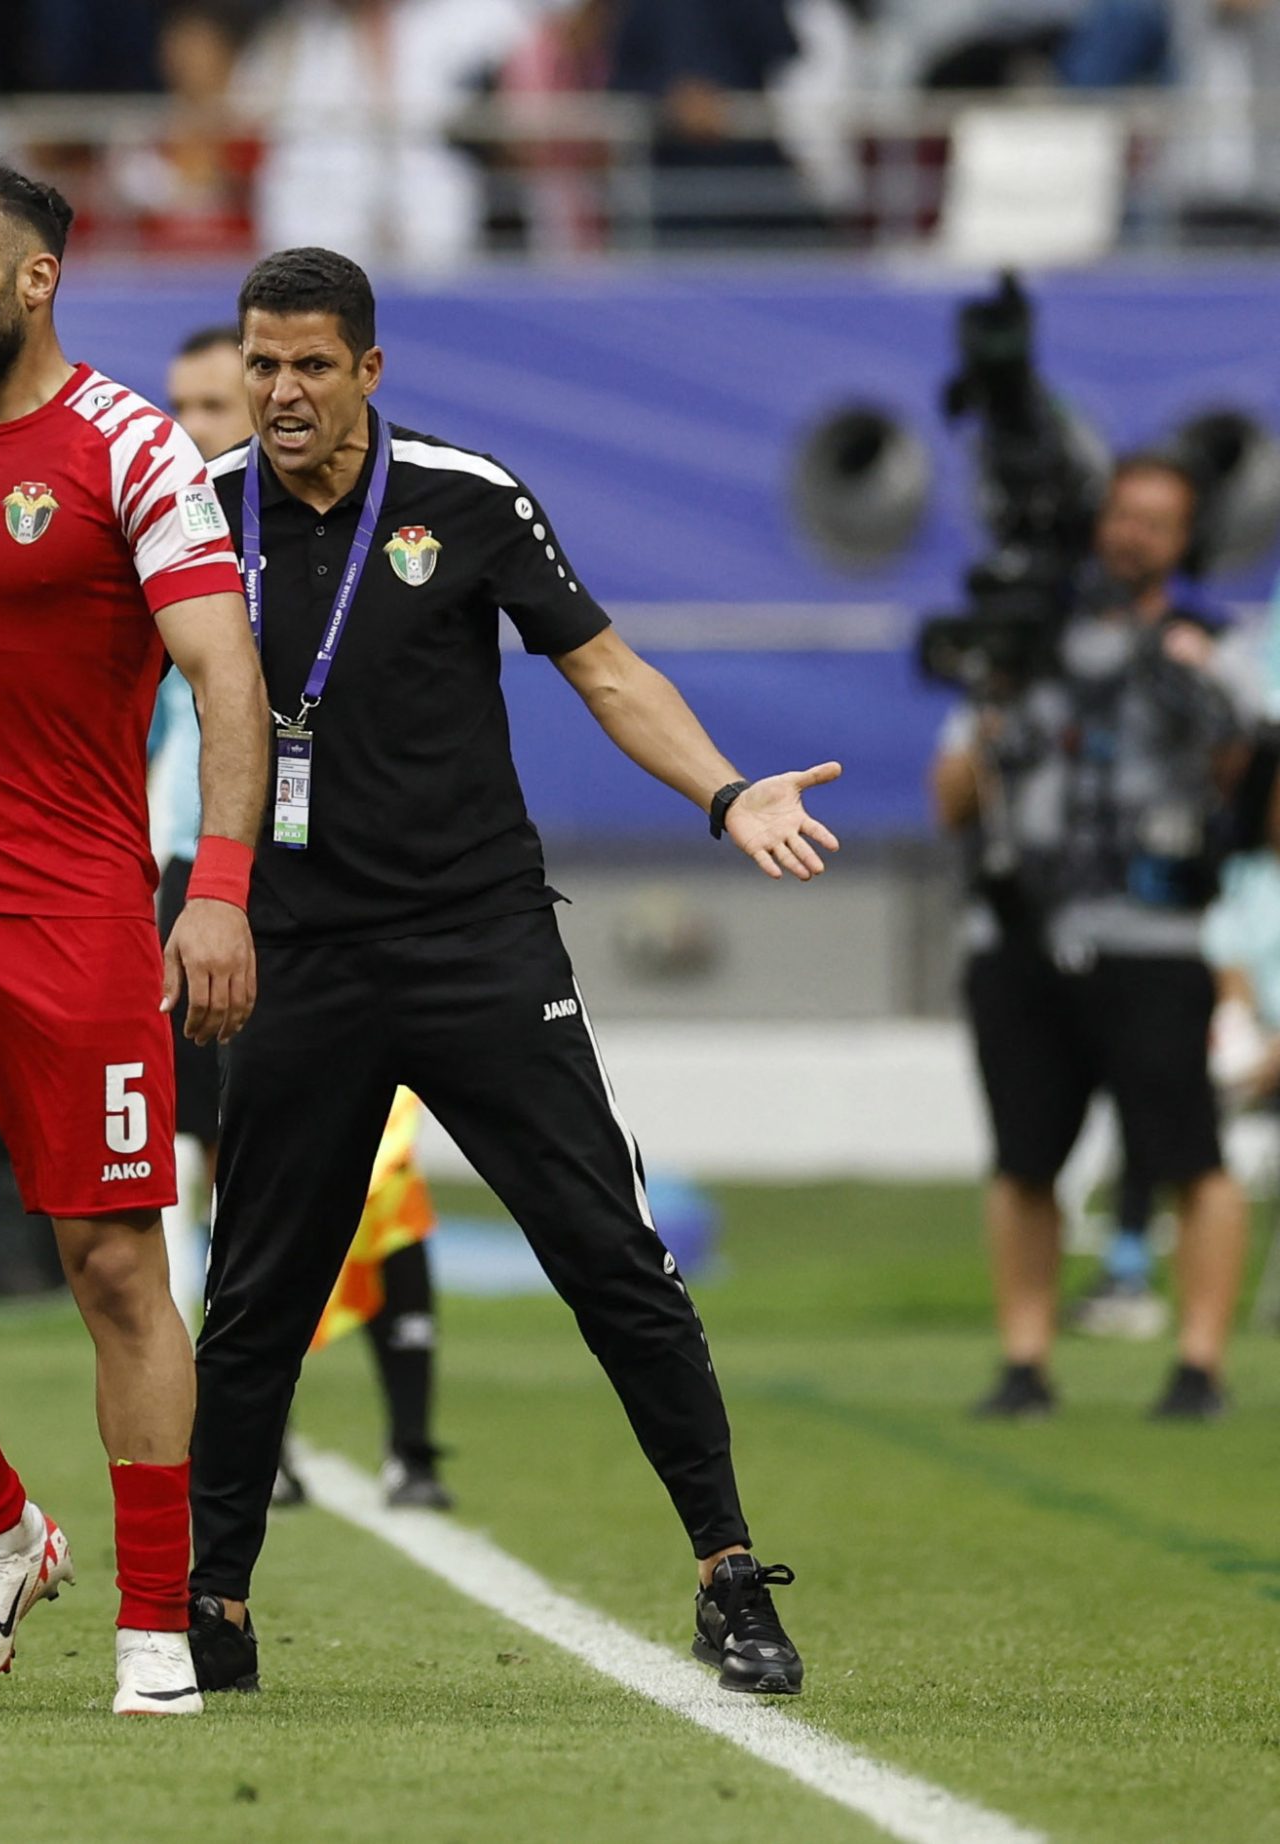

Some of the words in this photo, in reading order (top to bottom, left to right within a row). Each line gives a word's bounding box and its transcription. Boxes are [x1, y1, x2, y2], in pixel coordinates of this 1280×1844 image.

[185, 493, 203, 503] AFC
[186, 502, 217, 517] LIVE
[246, 569, 258, 600] Hayya
[249, 601, 259, 622] Asia
[542, 997, 579, 1022] JAKO
[105, 1062, 148, 1154] 5
[100, 1161, 152, 1183] JAKO
